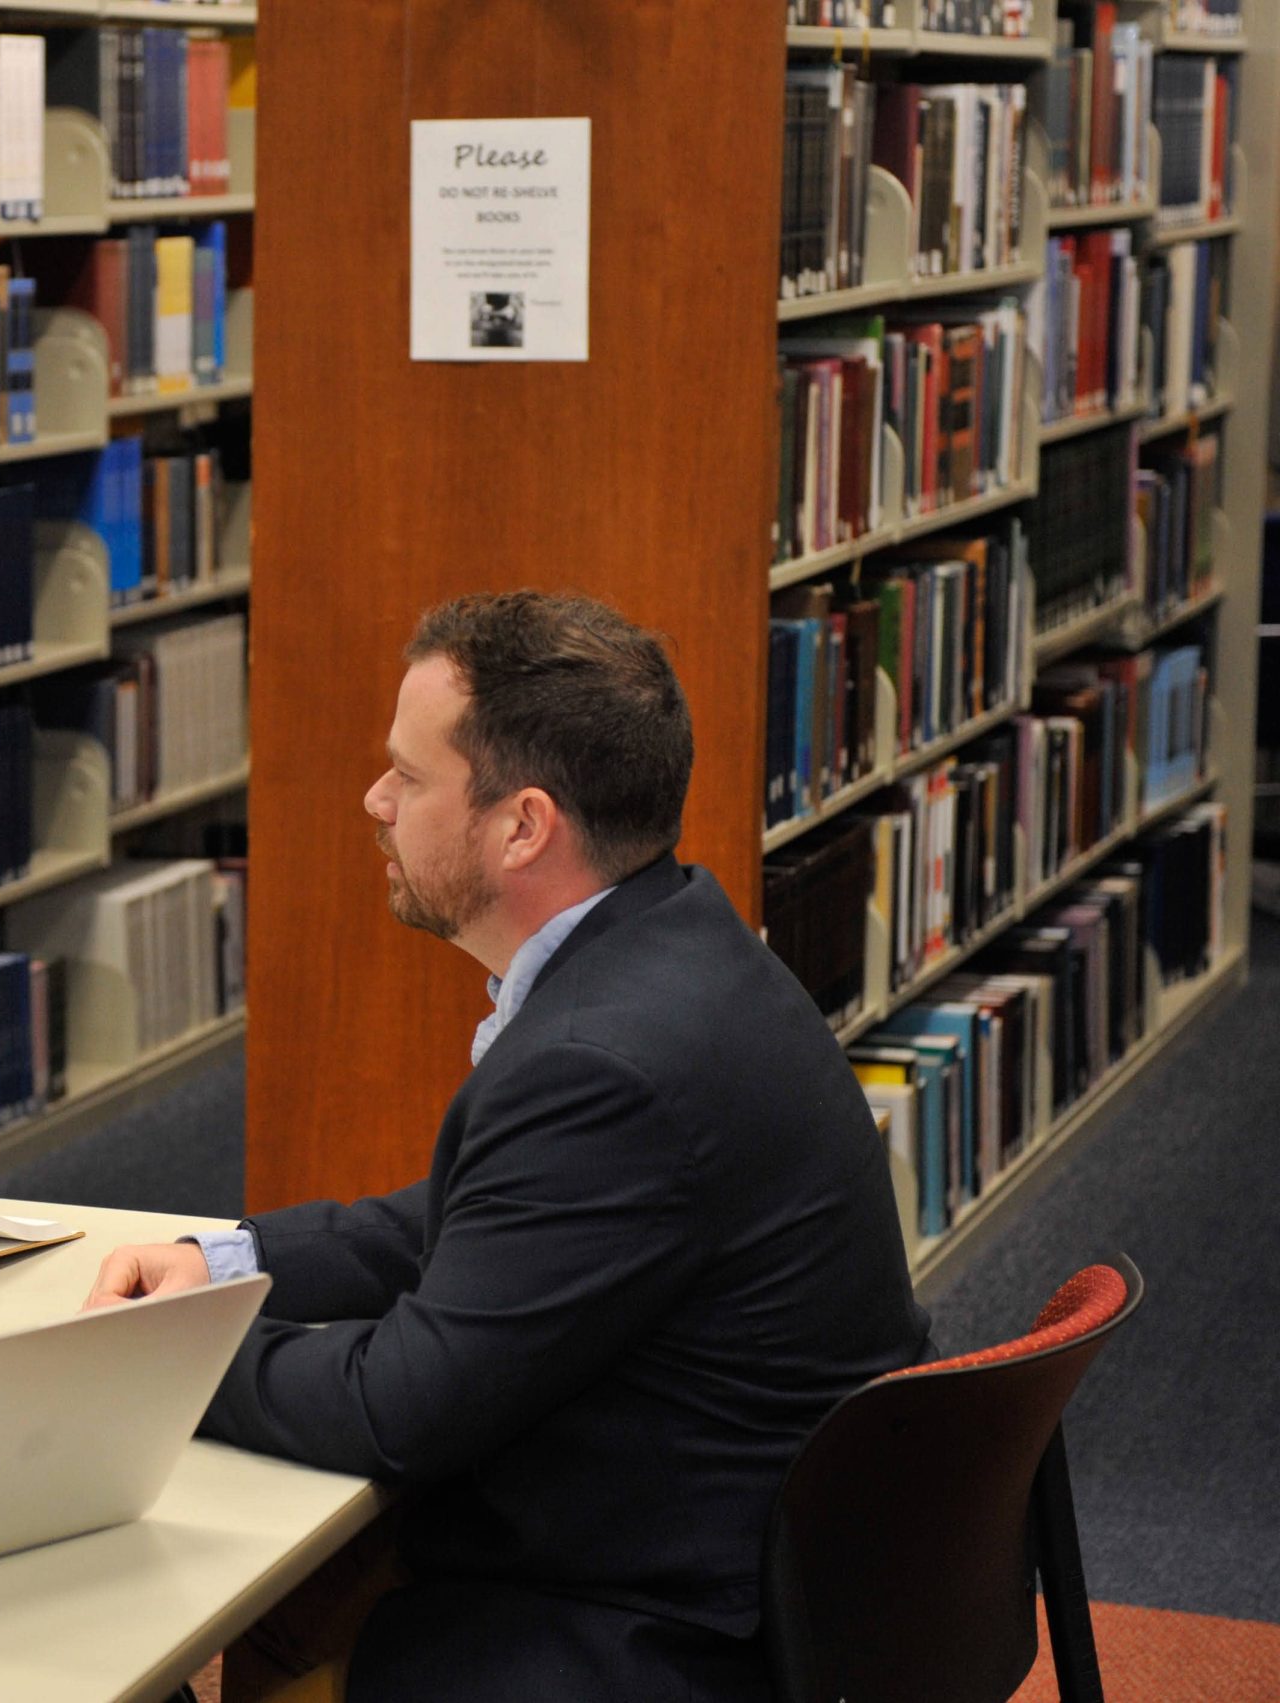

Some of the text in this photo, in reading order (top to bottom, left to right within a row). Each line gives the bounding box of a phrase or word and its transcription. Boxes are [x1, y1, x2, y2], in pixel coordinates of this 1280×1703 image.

[454, 143, 548, 170] Please
[462, 186, 489, 199] NOT
[475, 210, 521, 223] BOOKS
